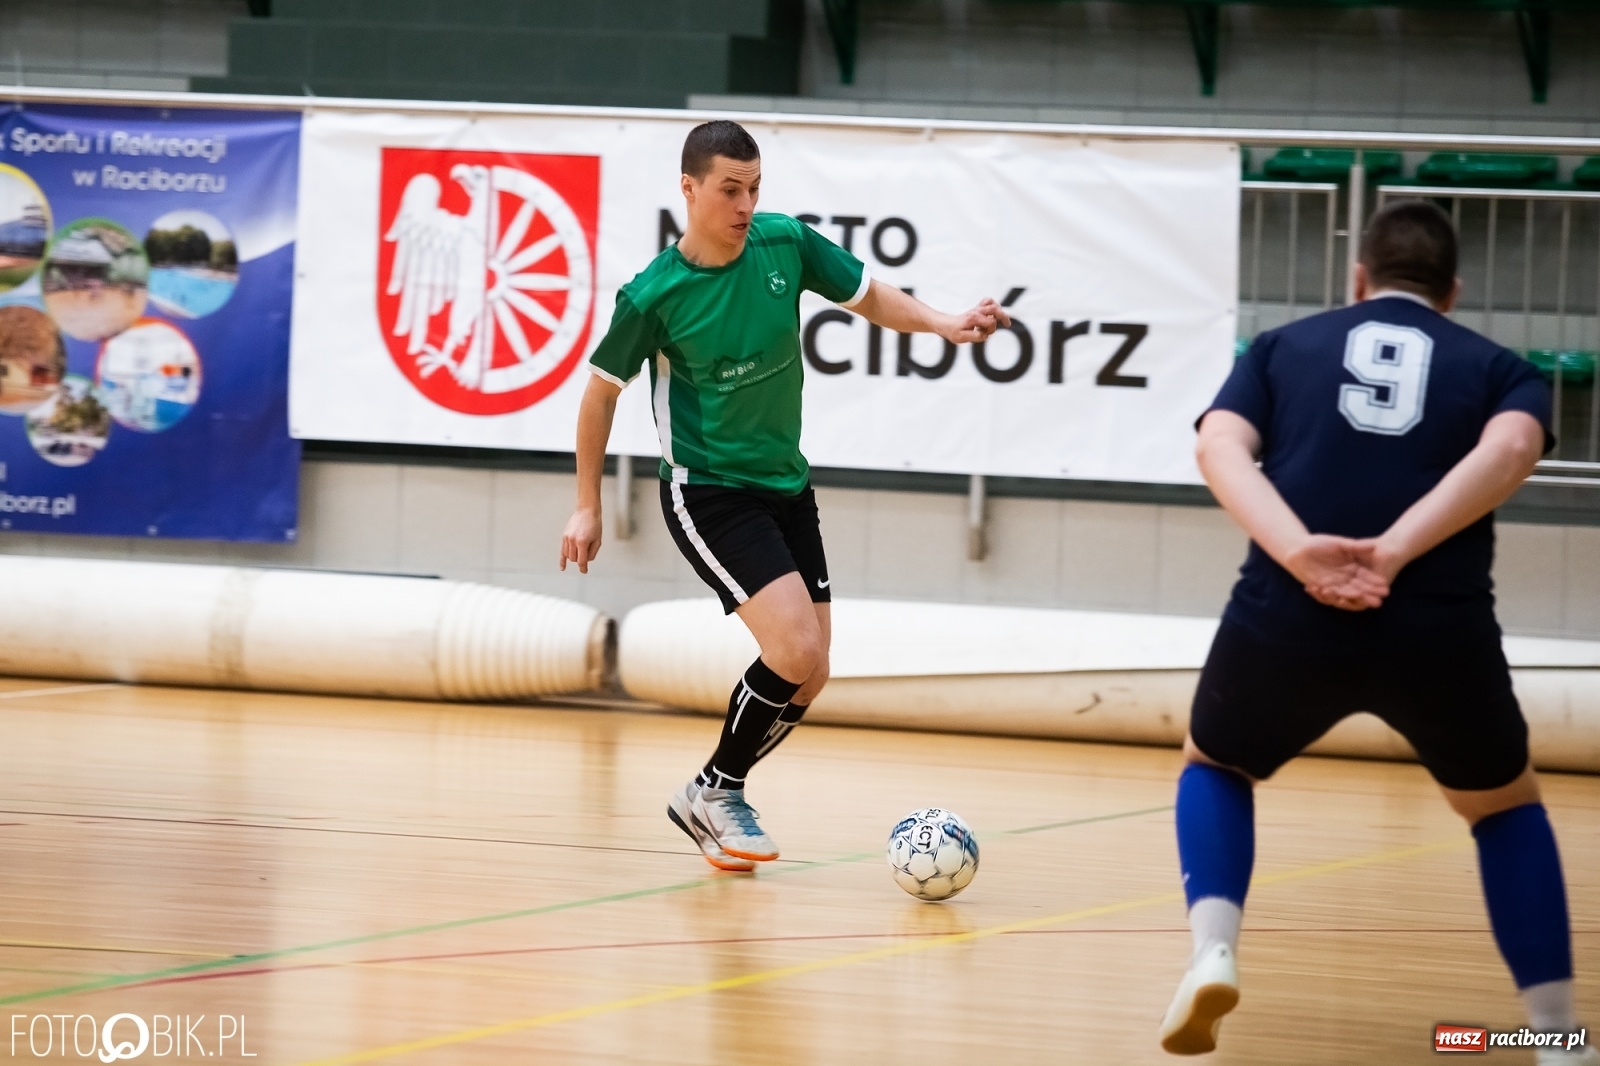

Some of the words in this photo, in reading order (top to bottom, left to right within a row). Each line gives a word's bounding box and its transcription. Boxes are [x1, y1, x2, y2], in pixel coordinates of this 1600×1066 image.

[10, 127, 91, 157] Sportu
[111, 130, 227, 163] Rekreacji
[72, 169, 97, 187] w
[101, 164, 226, 193] Raciborzu
[802, 287, 1149, 389] cibórz
[1337, 320, 1435, 436] 9
